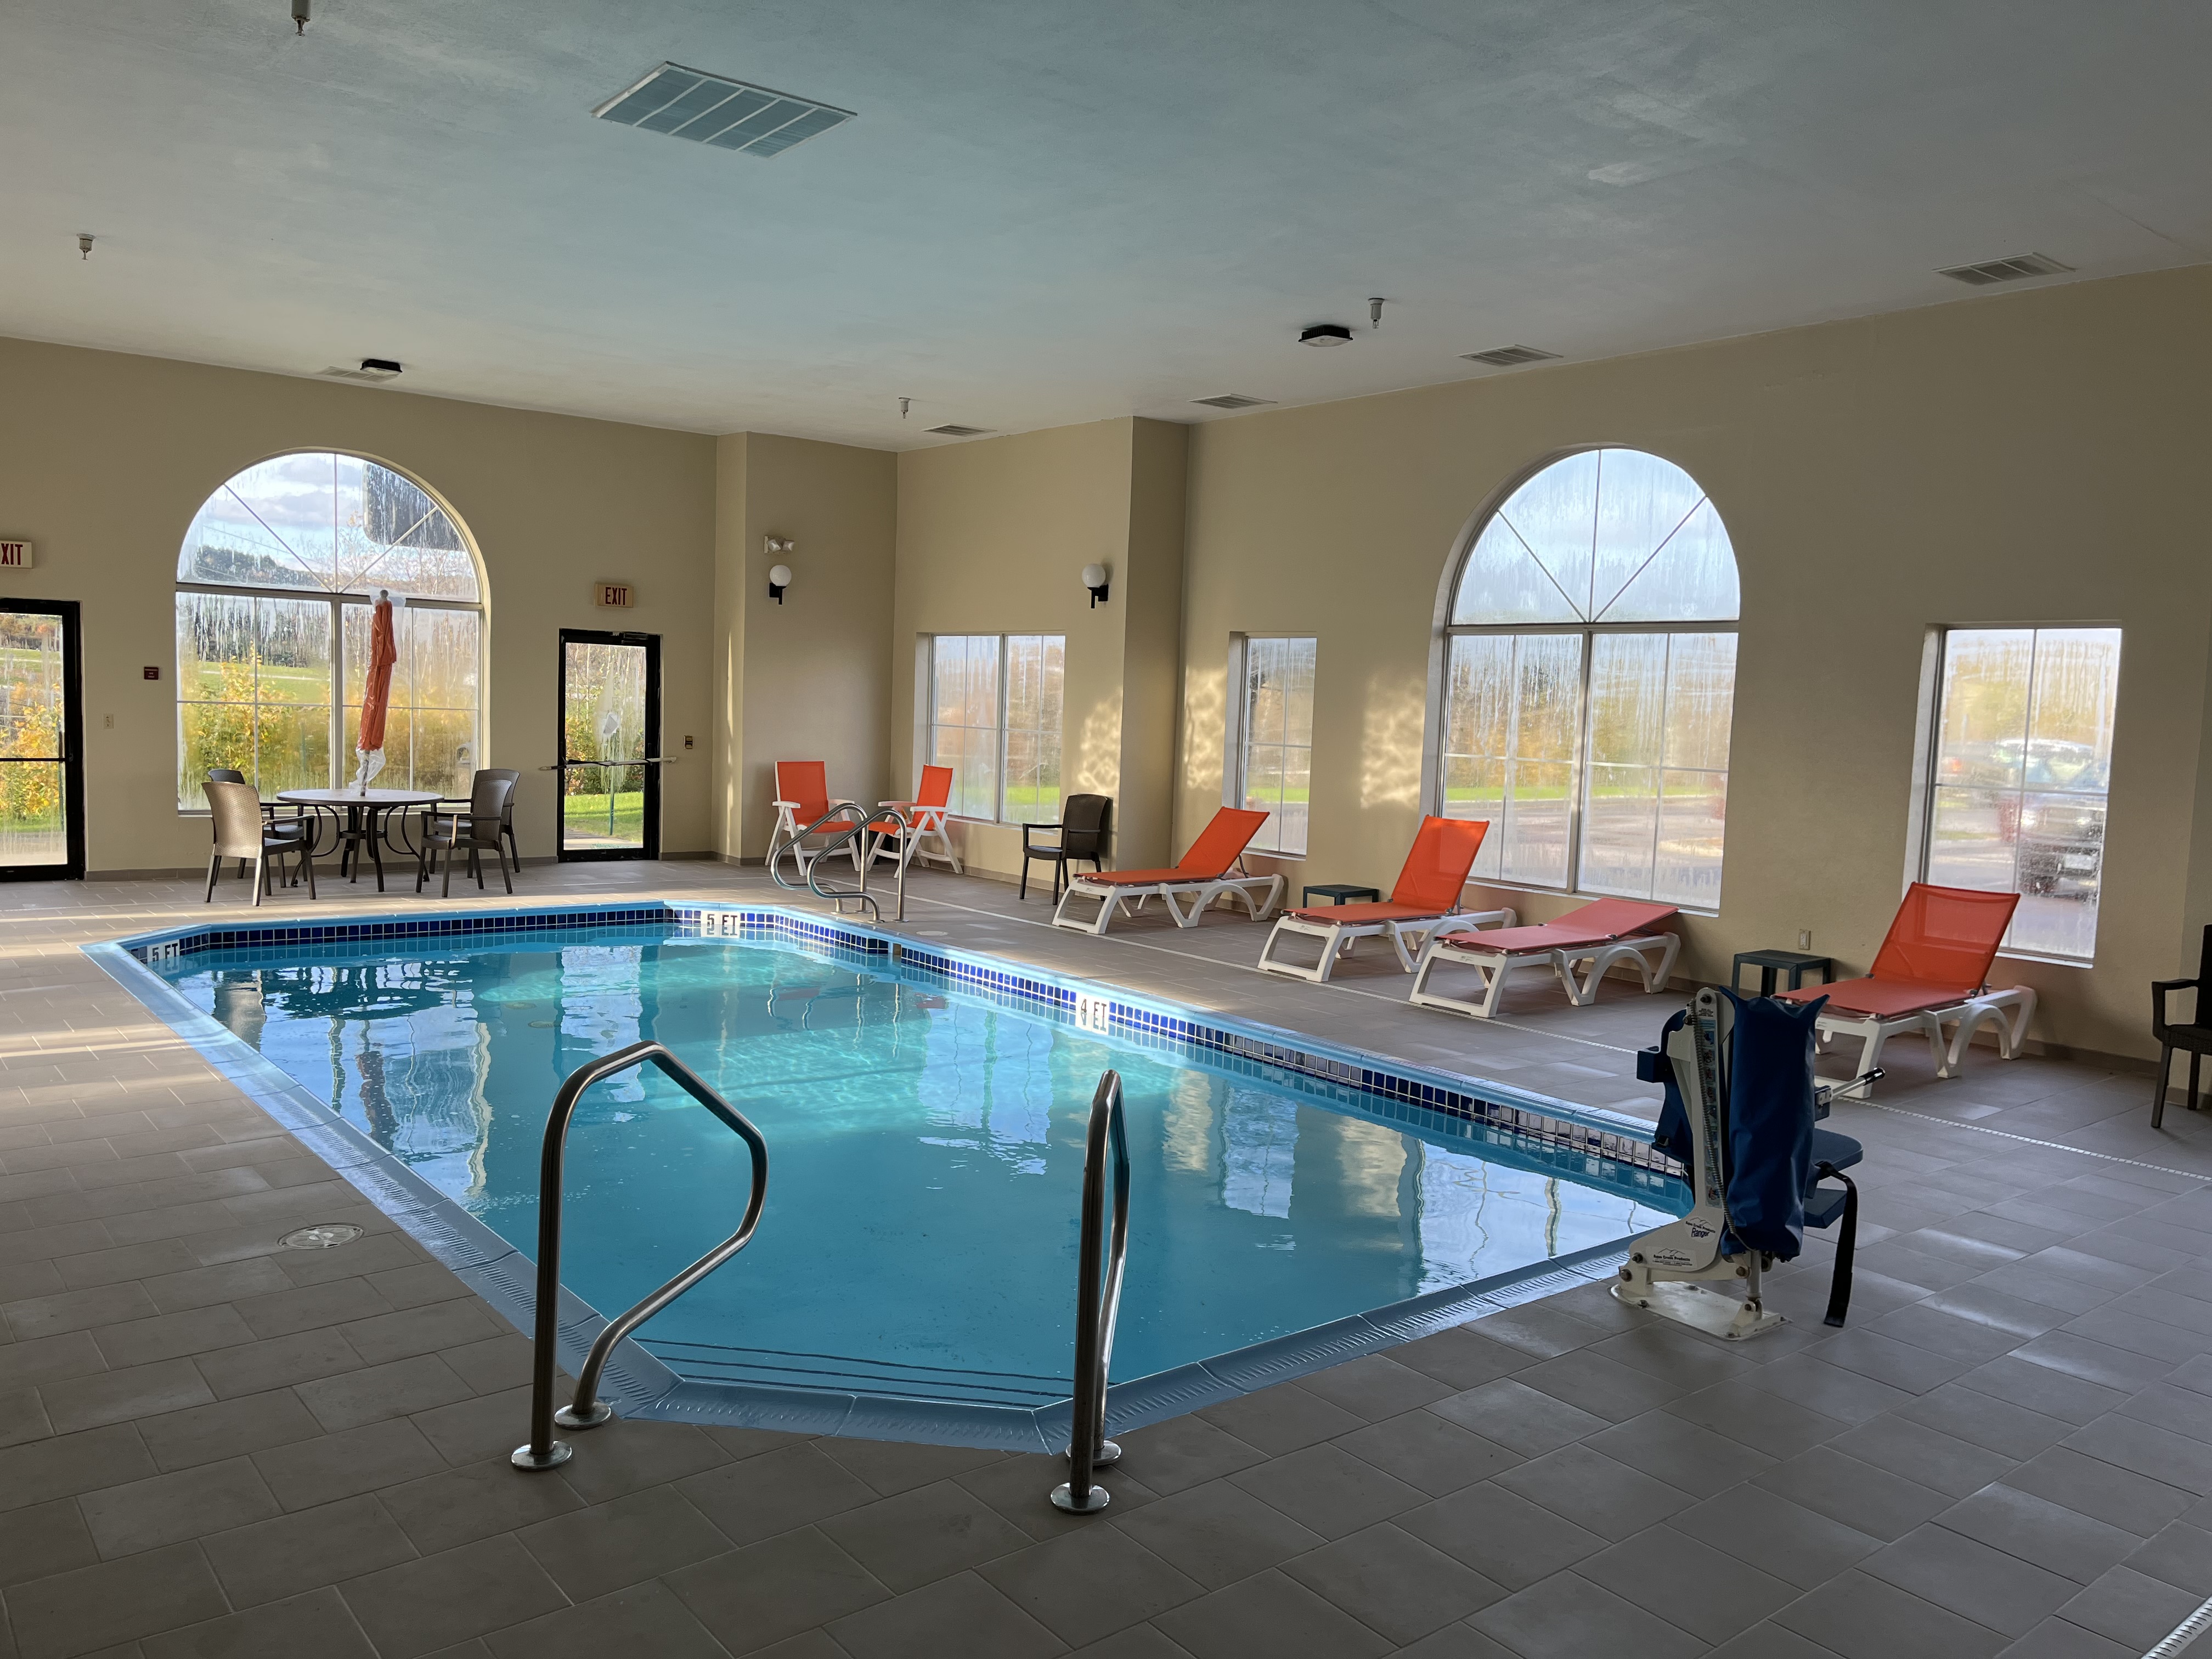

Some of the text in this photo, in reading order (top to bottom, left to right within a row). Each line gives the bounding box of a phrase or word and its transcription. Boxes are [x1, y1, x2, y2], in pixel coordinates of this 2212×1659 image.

[1, 543, 23, 565] XIT
[605, 586, 627, 605] EXIT
[707, 913, 738, 926] 5 FT
[152, 943, 178, 962] 5 FT
[1081, 998, 1107, 1018] 4 FT
[1691, 1227, 1710, 1238] Ranger
